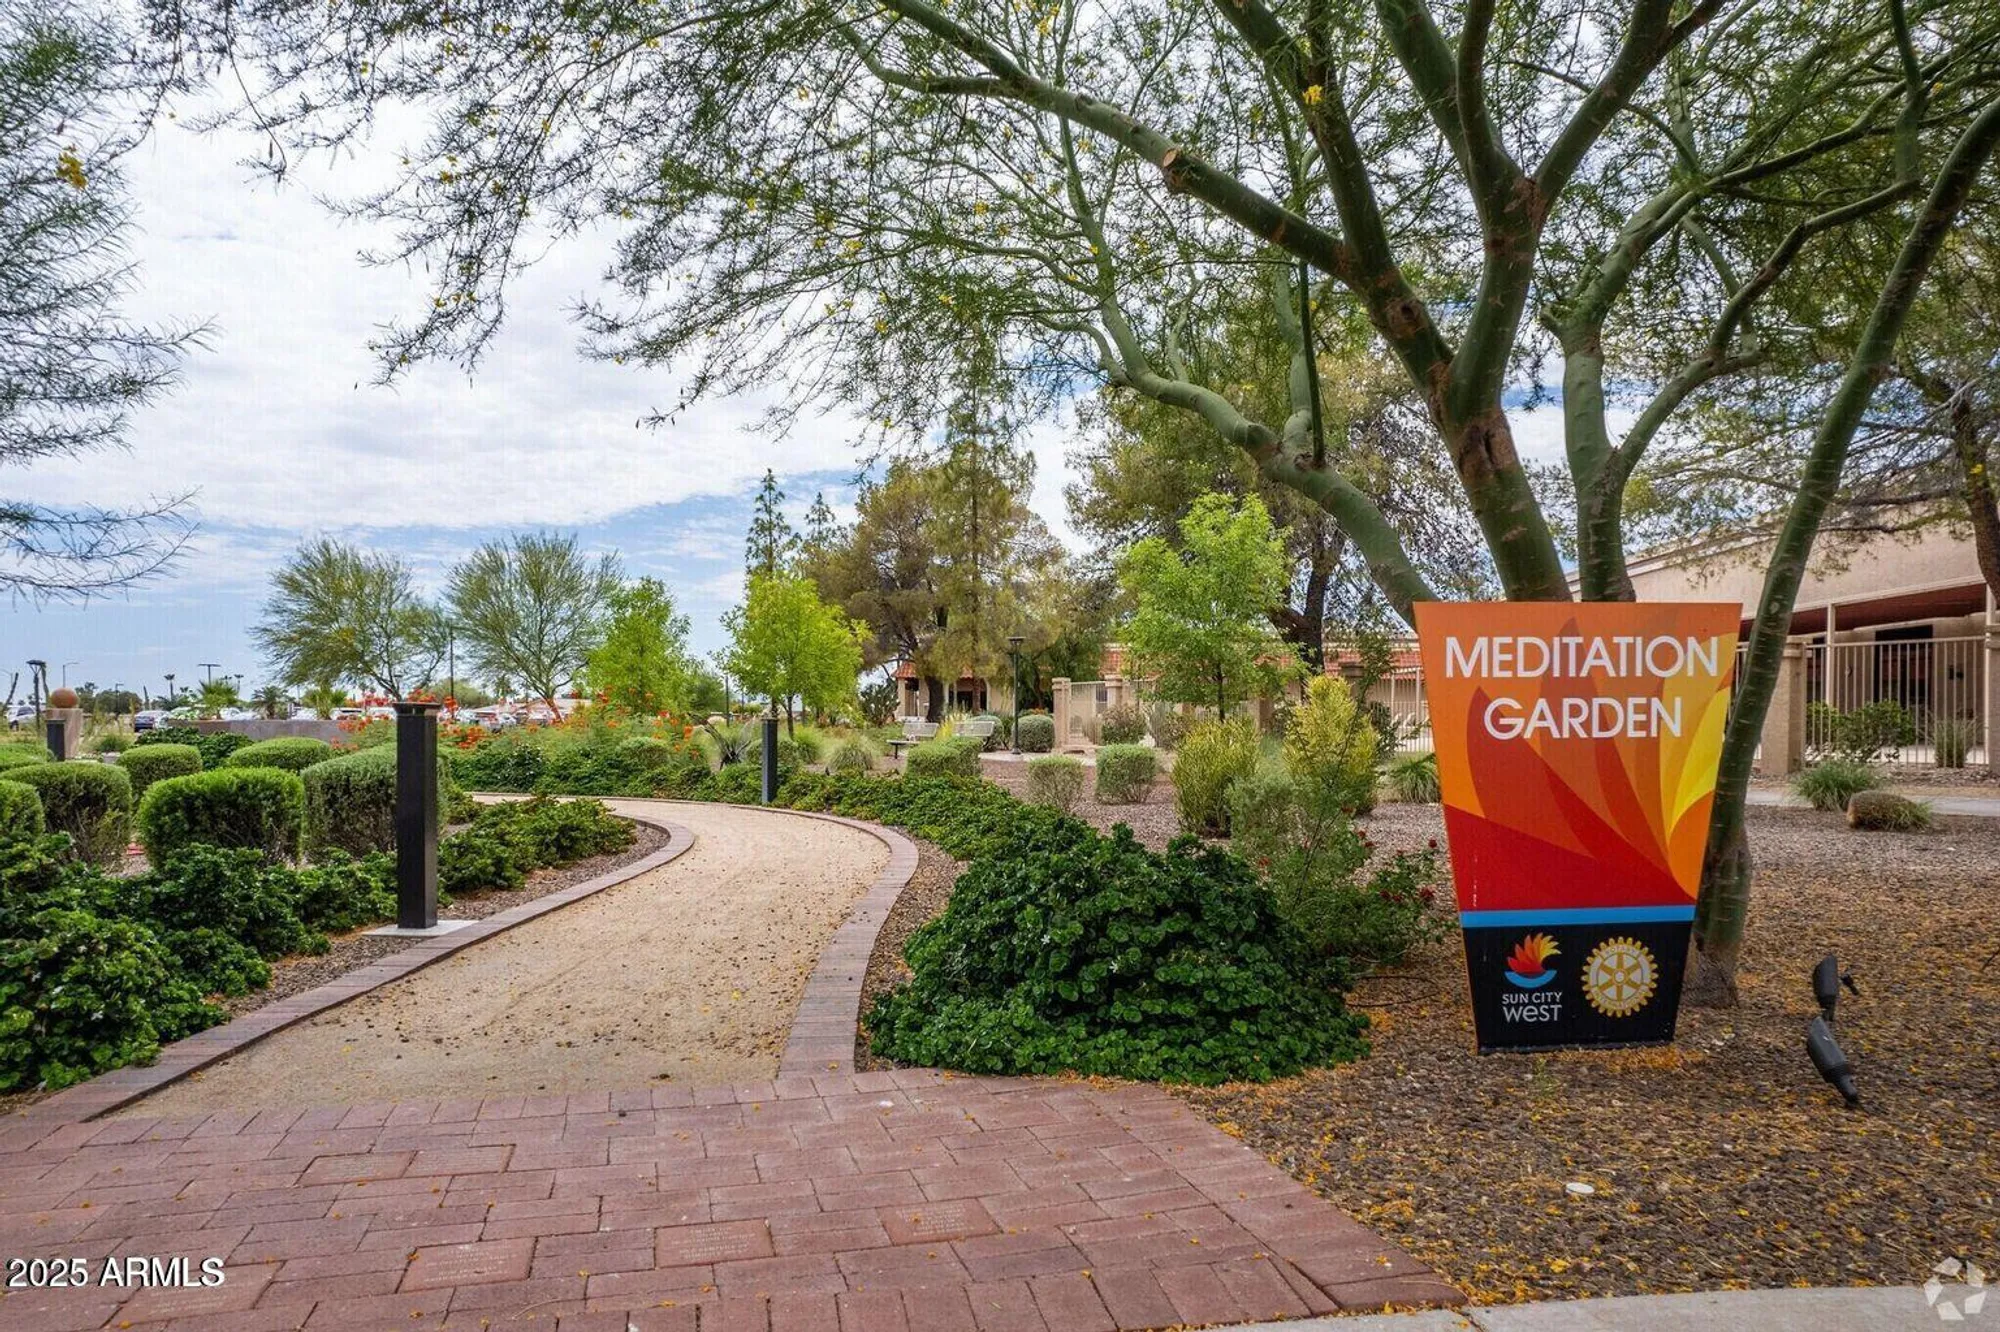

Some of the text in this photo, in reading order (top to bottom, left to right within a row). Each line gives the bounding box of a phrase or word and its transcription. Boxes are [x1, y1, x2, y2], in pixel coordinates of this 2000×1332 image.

[1446, 636, 1718, 678] MEDITATION
[1484, 697, 1682, 740] GARDEN
[1502, 992, 1562, 1004] SUN CITY
